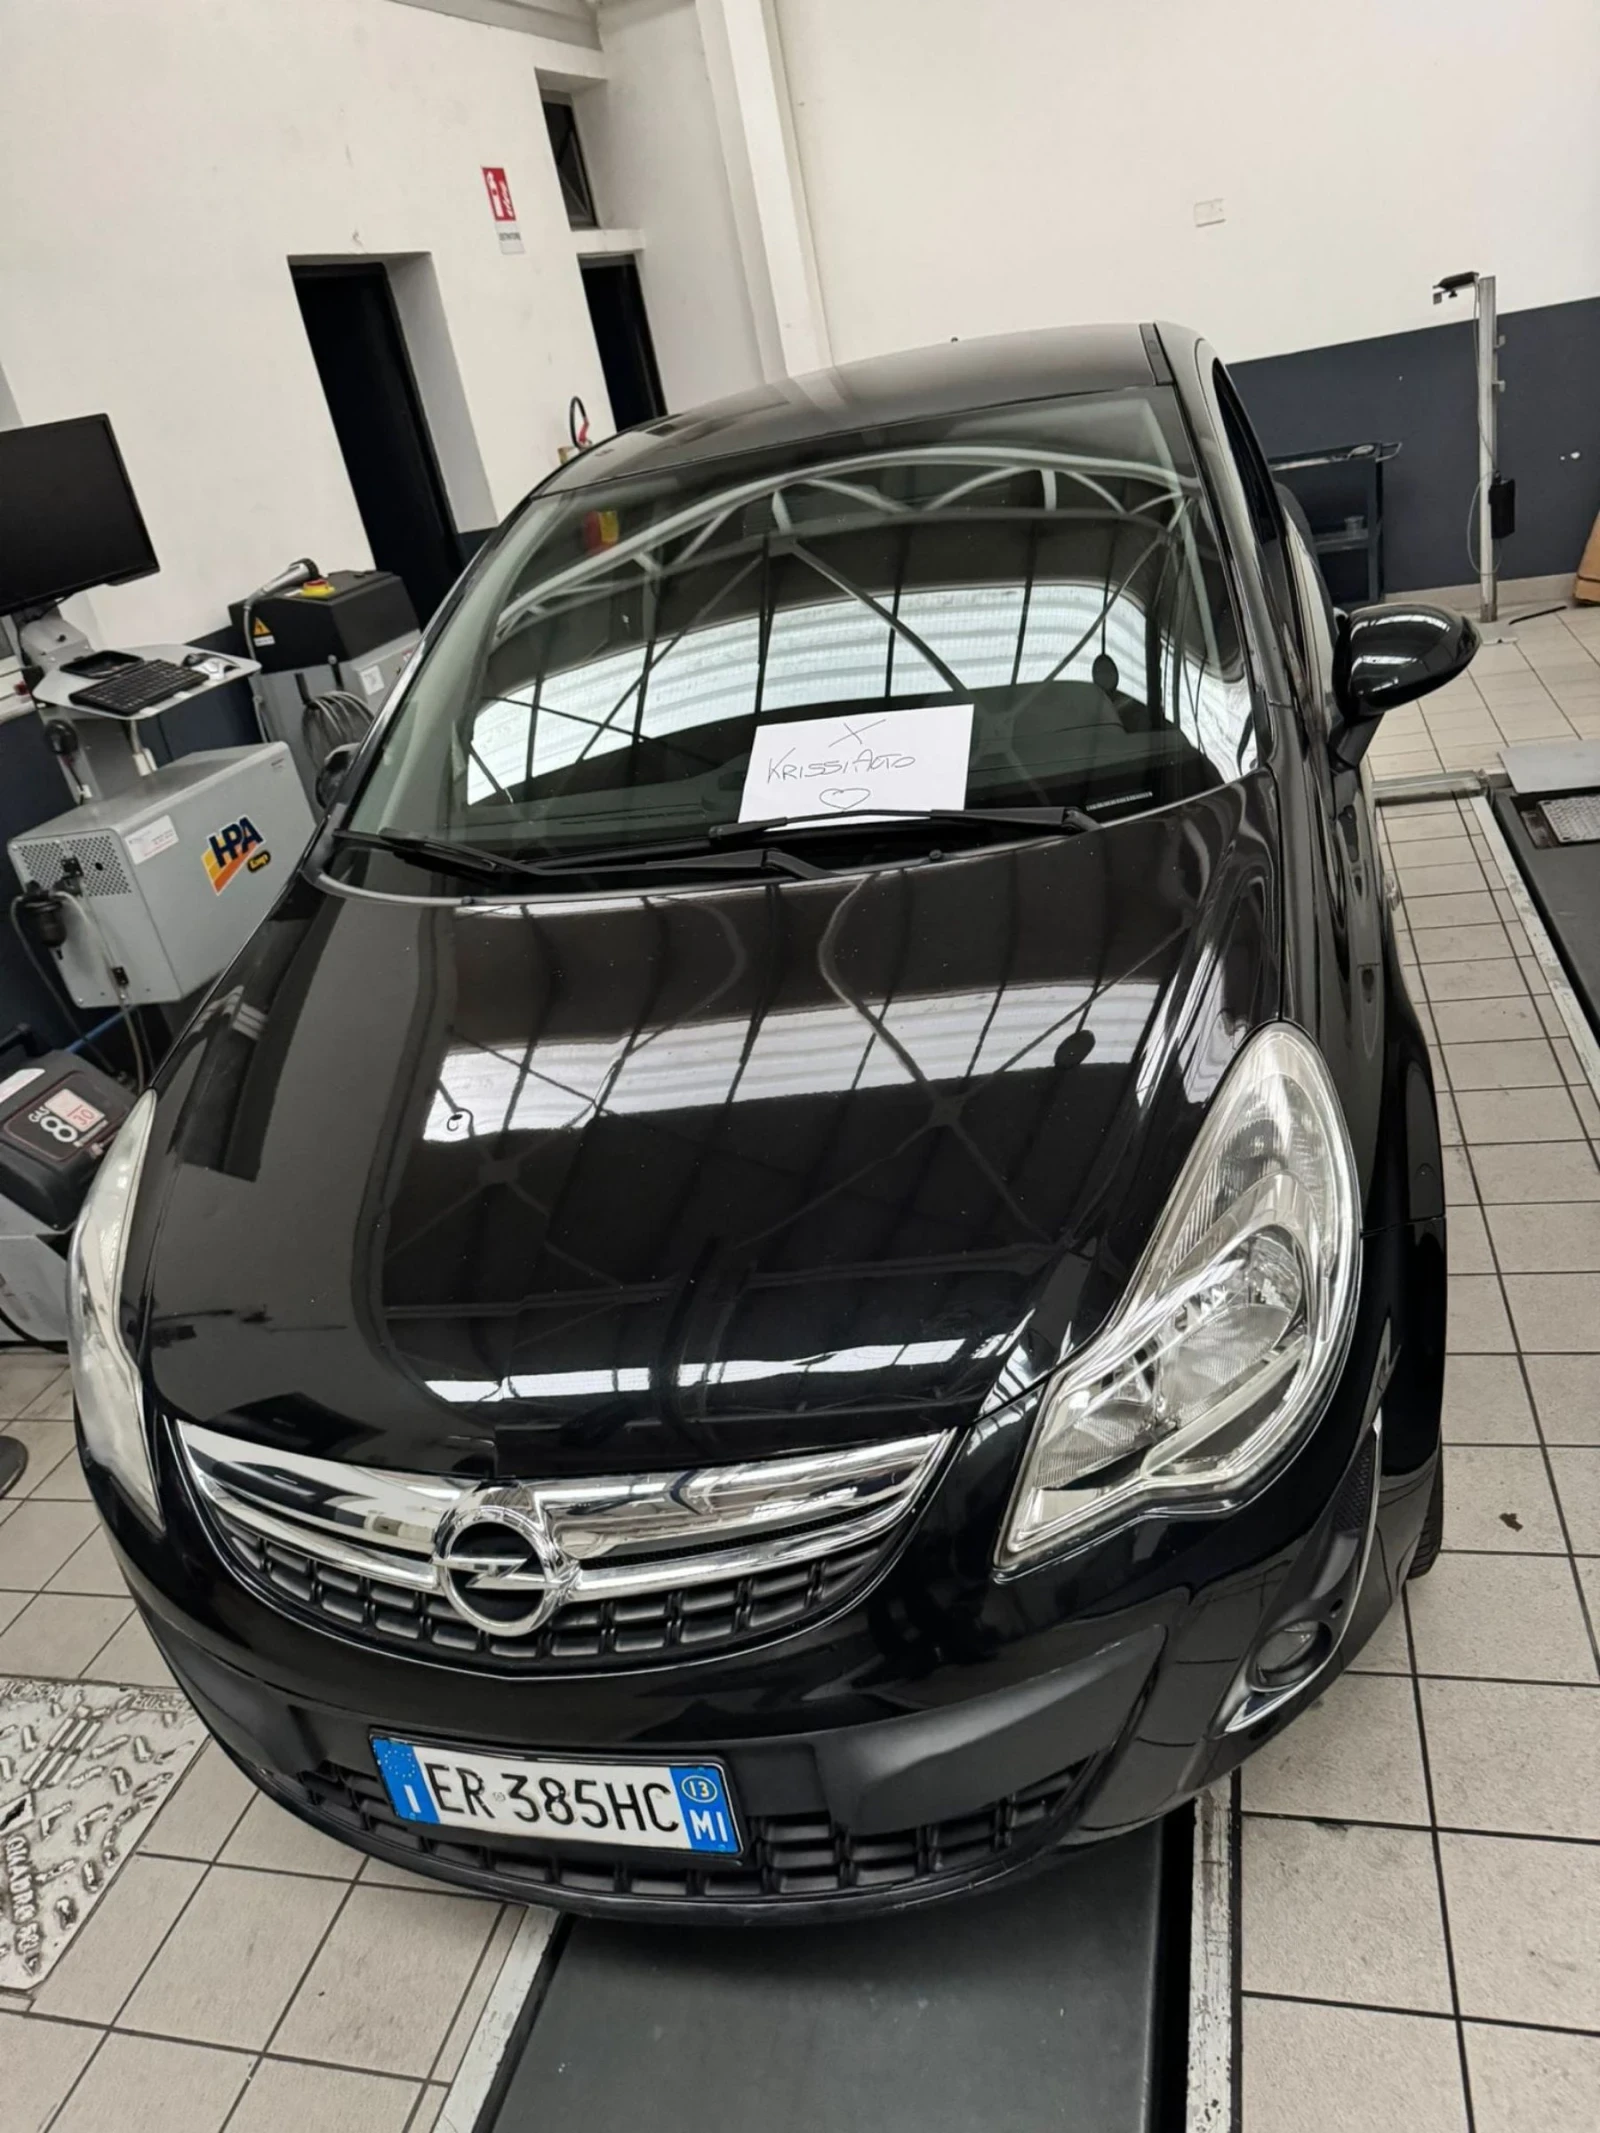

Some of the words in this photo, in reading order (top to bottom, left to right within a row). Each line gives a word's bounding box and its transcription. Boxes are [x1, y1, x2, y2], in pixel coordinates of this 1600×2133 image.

[208, 816, 264, 869] HPA
[403, 1785, 420, 1814] I
[689, 1777, 711, 1799] 13
[692, 1808, 729, 1843] MI
